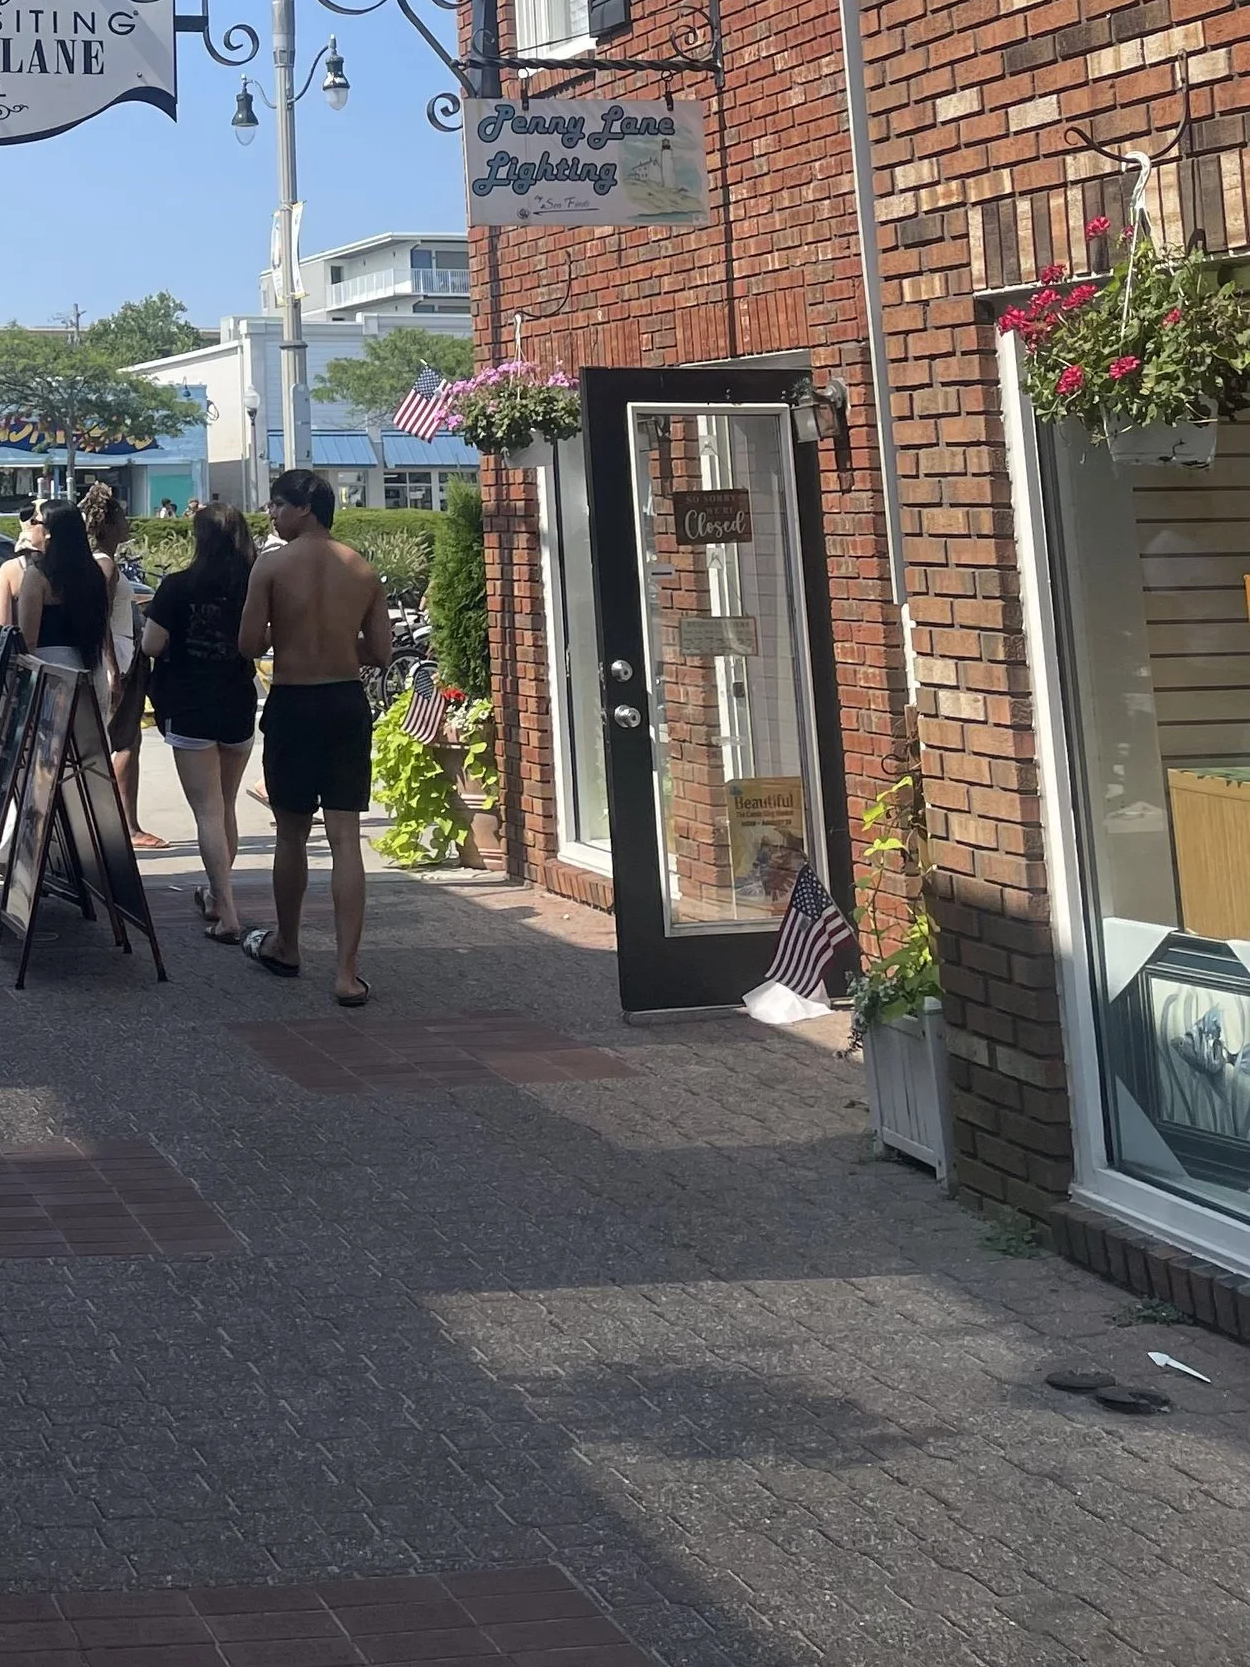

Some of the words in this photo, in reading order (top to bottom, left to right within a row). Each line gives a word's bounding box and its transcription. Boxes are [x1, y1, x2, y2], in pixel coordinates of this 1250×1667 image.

[0, 37, 105, 76] LANE
[477, 104, 585, 149] Penny
[587, 105, 676, 150] Lane
[472, 150, 618, 196] Lighting
[684, 509, 746, 540] Closed
[734, 793, 794, 810] Beautiful
